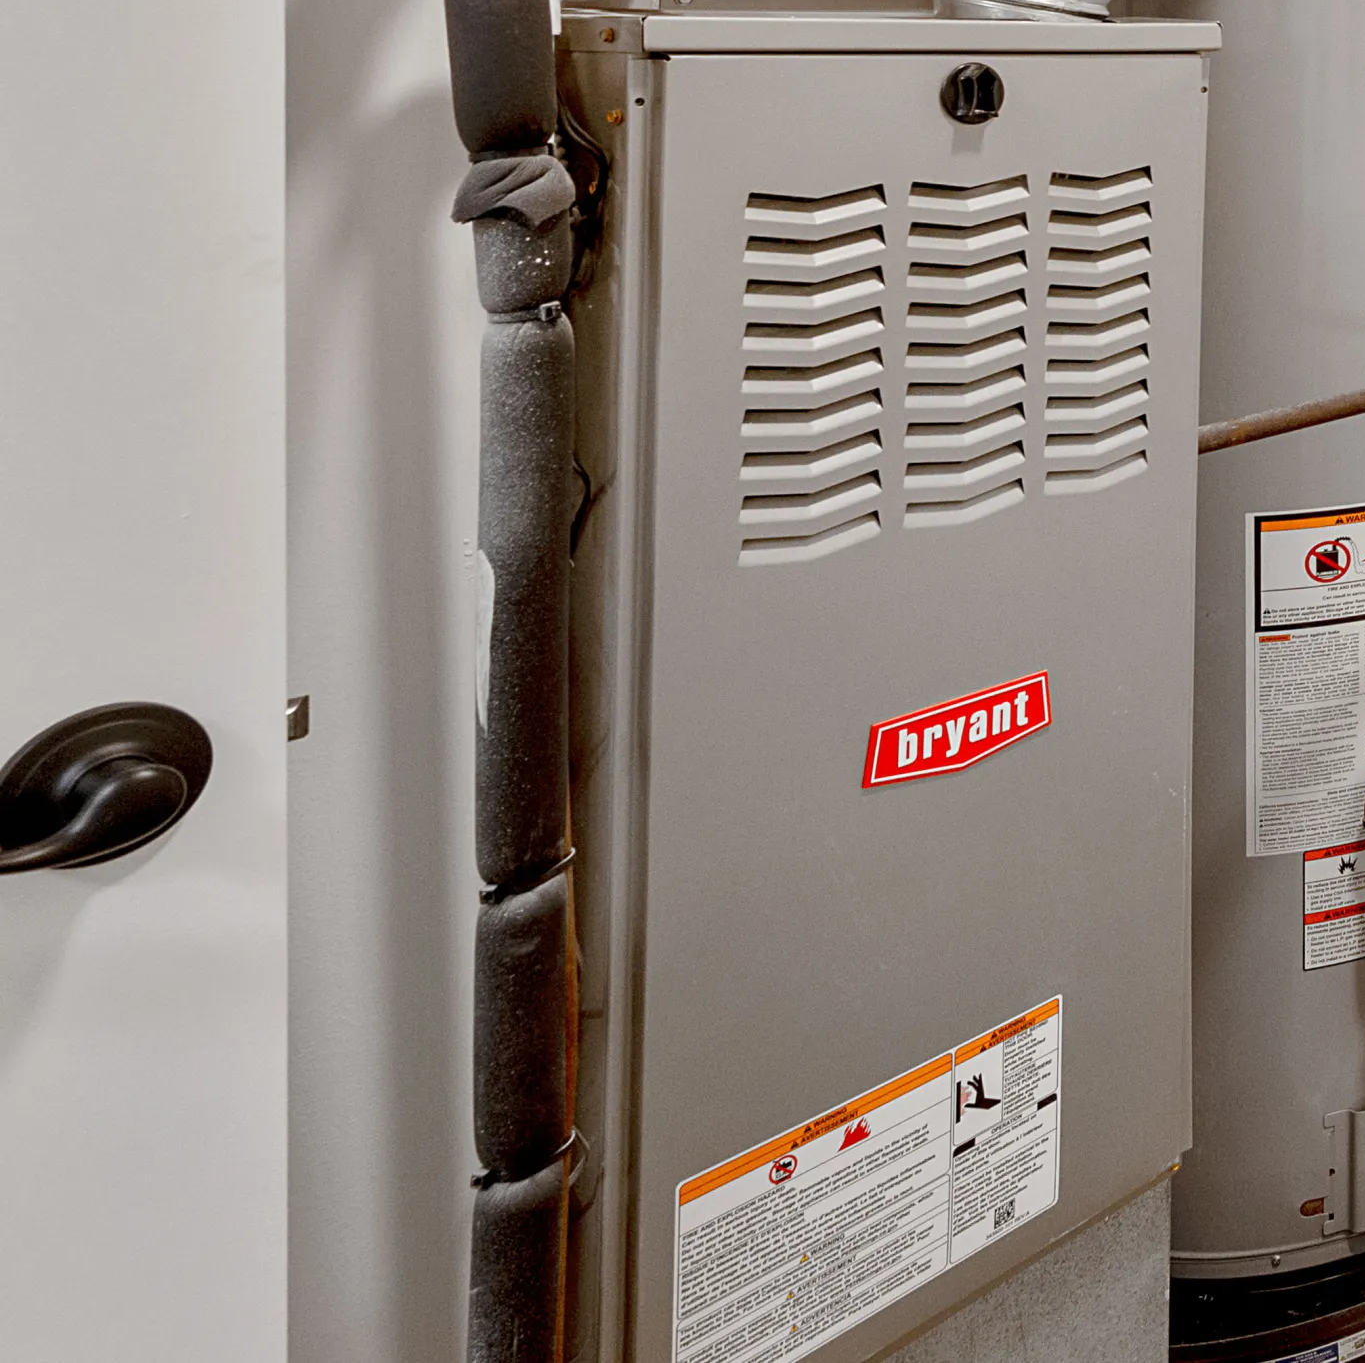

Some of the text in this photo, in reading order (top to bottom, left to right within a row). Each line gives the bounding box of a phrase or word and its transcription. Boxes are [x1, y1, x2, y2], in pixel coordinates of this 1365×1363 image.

[897, 690, 1029, 768] bryant
[998, 1016, 1026, 1033] WARNING
[1005, 1033, 1032, 1049] THIS DOOR
[801, 1111, 858, 1142] AVERTISSEMENT
[813, 1107, 847, 1127] WARNING
[991, 1114, 1022, 1133] OPERATION
[682, 1185, 785, 1241] FIRE AND EXPLOSION HAZARD
[682, 1238, 695, 1248] Can
[697, 1227, 715, 1240] result
[725, 1211, 748, 1226] serious
[750, 1200, 768, 1214] injury
[778, 1186, 795, 1198] death.
[681, 1213, 804, 1279] RISQUE D'INCENDIE ET D'EXPLOSION
[810, 1234, 844, 1255] WARNING
[797, 1256, 856, 1291] AVERTISSEMENT
[800, 1293, 851, 1325] ADVERTENCIA
